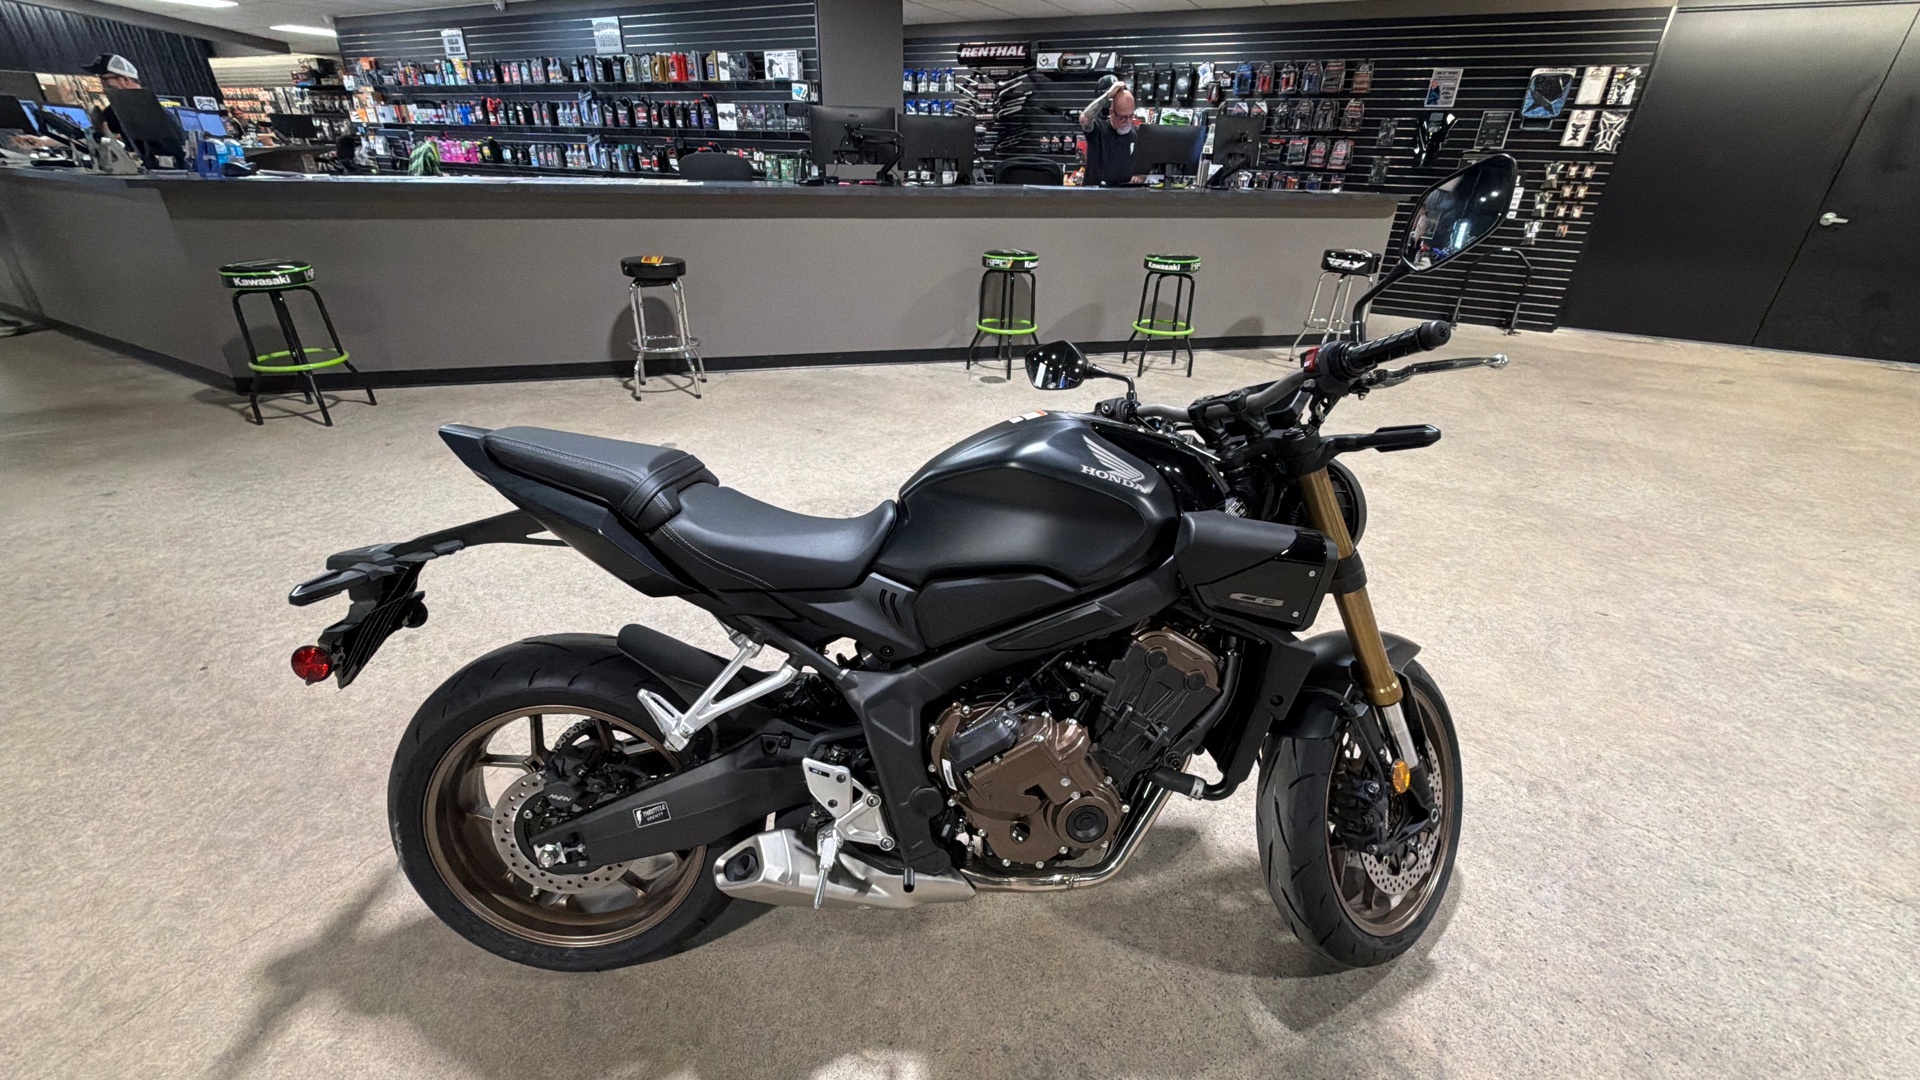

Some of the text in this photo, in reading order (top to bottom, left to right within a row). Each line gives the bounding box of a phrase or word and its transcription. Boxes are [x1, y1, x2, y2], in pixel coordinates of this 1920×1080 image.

[960, 46, 1026, 58] RENTHAL
[1147, 261, 1181, 271] Kawasaki
[232, 274, 291, 287] Kawasaki
[1080, 464, 1147, 494] HONDA
[642, 803, 666, 818] THROTTLE
